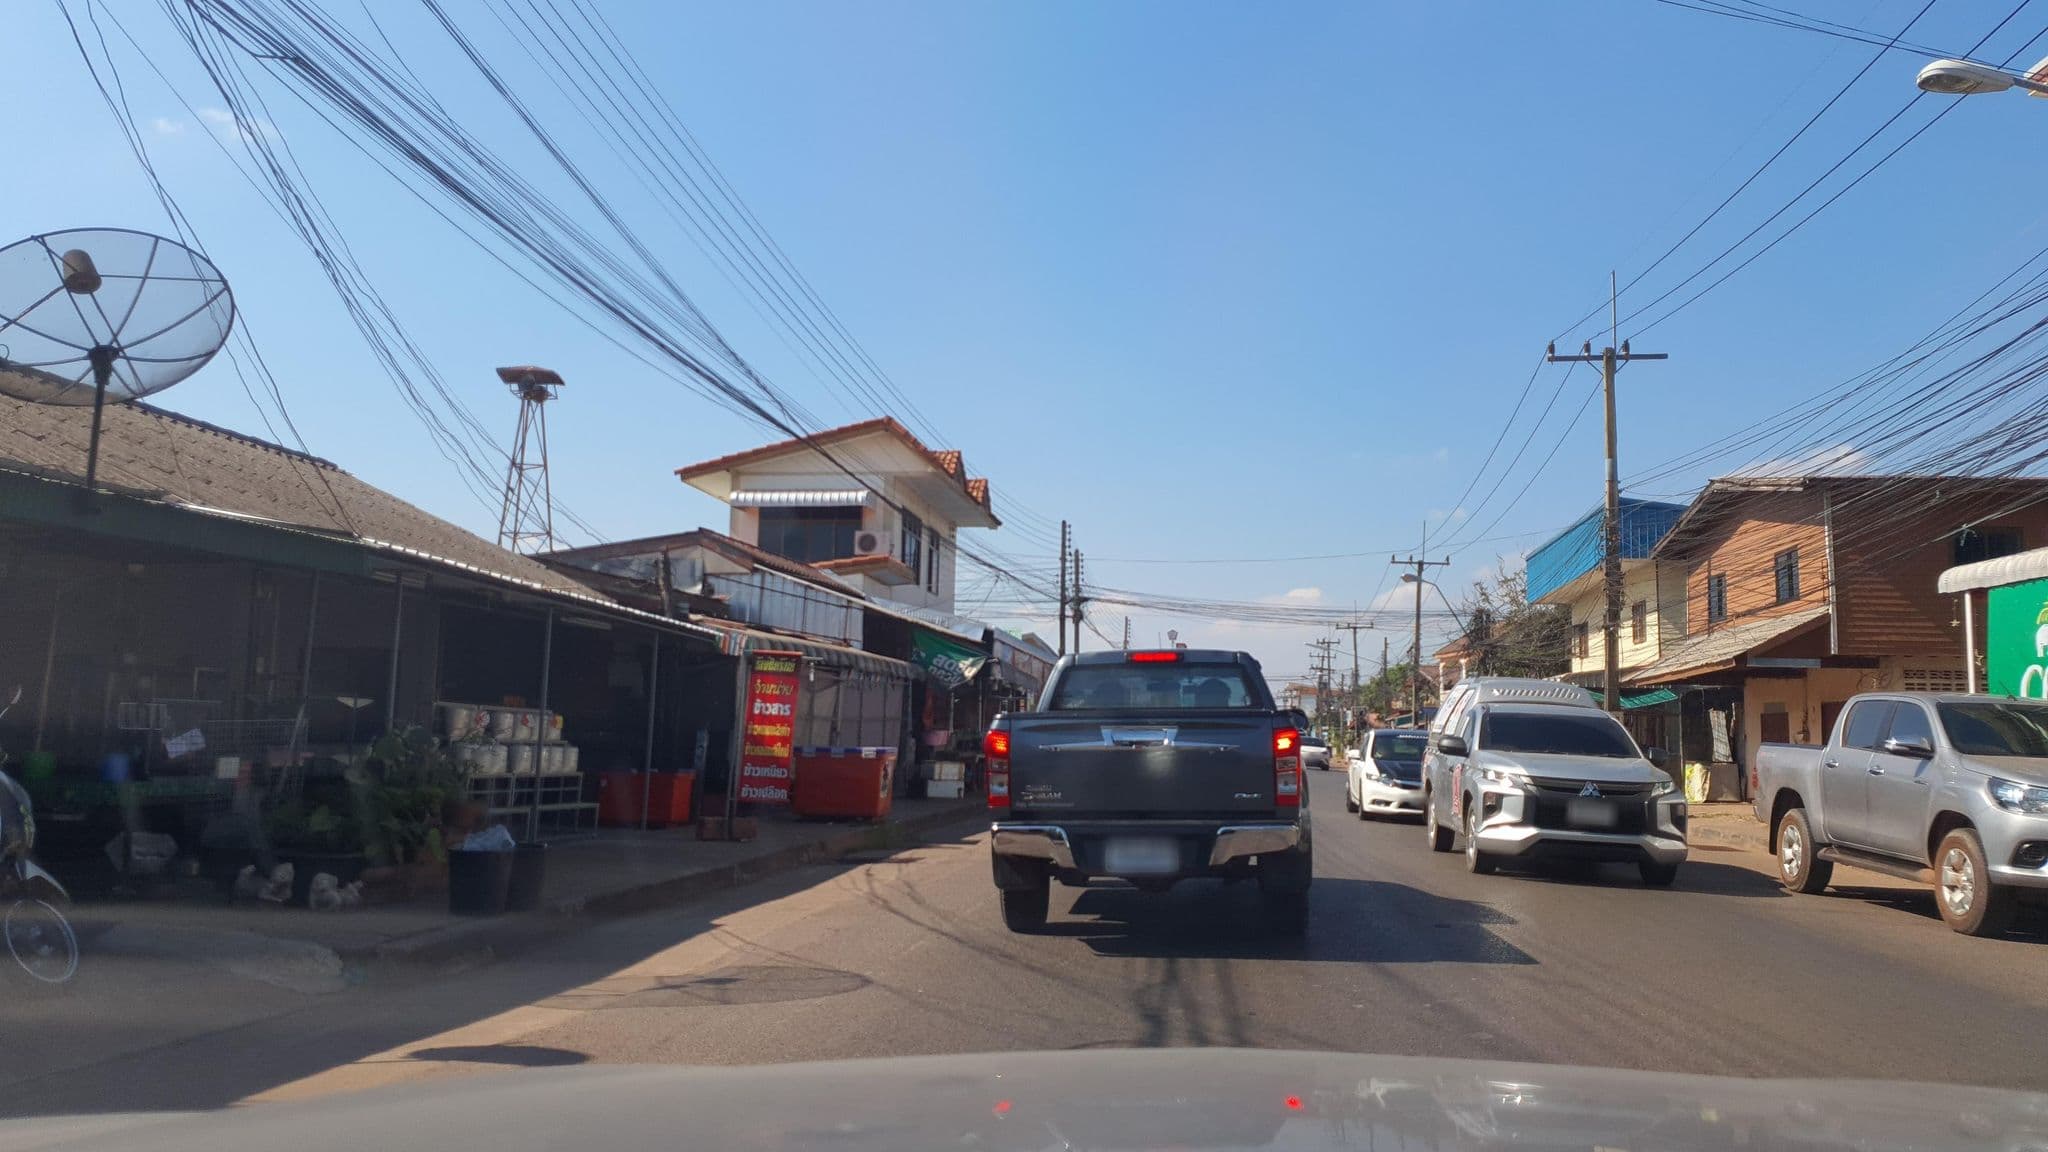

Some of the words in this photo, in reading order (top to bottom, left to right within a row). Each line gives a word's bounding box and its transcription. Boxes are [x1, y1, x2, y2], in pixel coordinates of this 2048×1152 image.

[753, 698, 791, 716] ข้าวสาร
[743, 762, 788, 778] ข้าวเหนียว
[741, 784, 788, 800] ข้าวเปลือก
